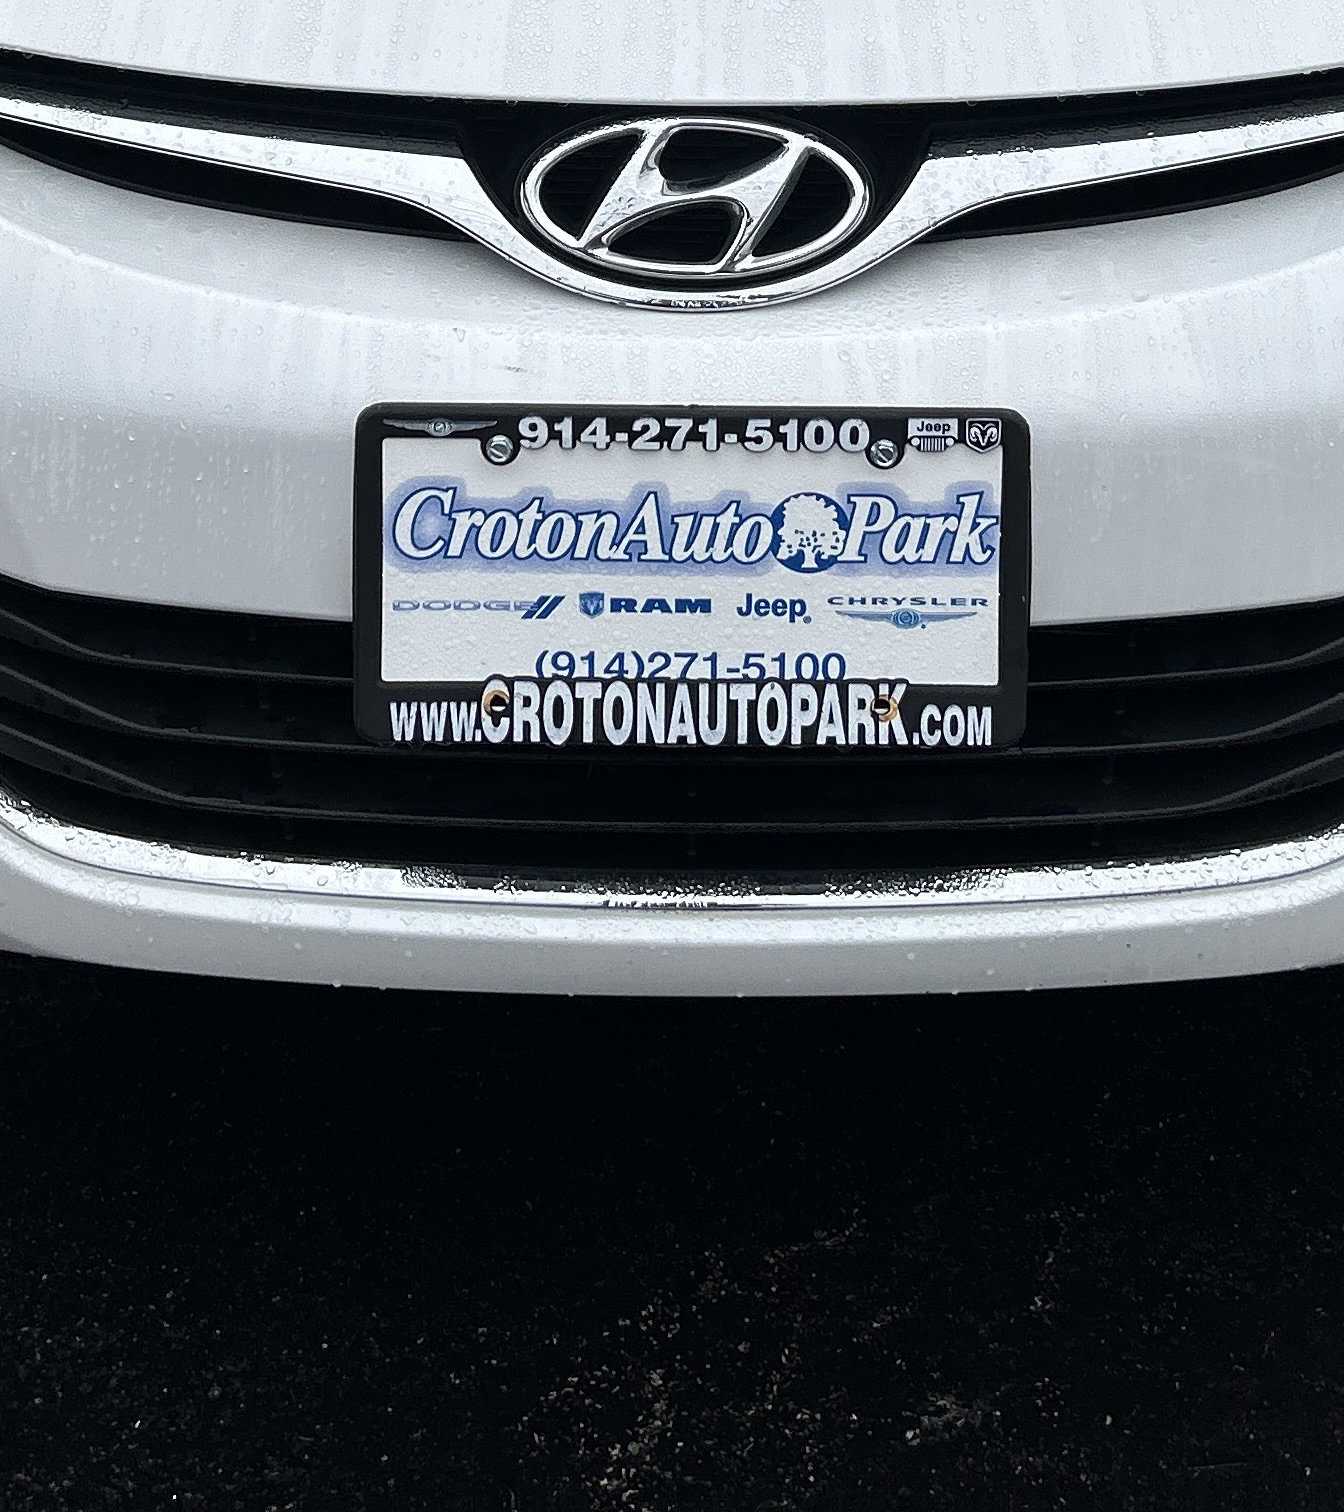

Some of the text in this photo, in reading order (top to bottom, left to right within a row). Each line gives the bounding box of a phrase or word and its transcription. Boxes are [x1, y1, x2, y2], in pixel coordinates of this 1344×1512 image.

[518, 415, 871, 452] 914-271-5100
[916, 421, 951, 435] Jeep
[392, 486, 999, 566] CrotonAuto Park
[392, 599, 537, 612] DODGE
[609, 597, 712, 614] RAM
[736, 592, 807, 624] Jeep
[827, 596, 989, 608] CHRYSLER
[535, 650, 847, 681] (914)271-5100
